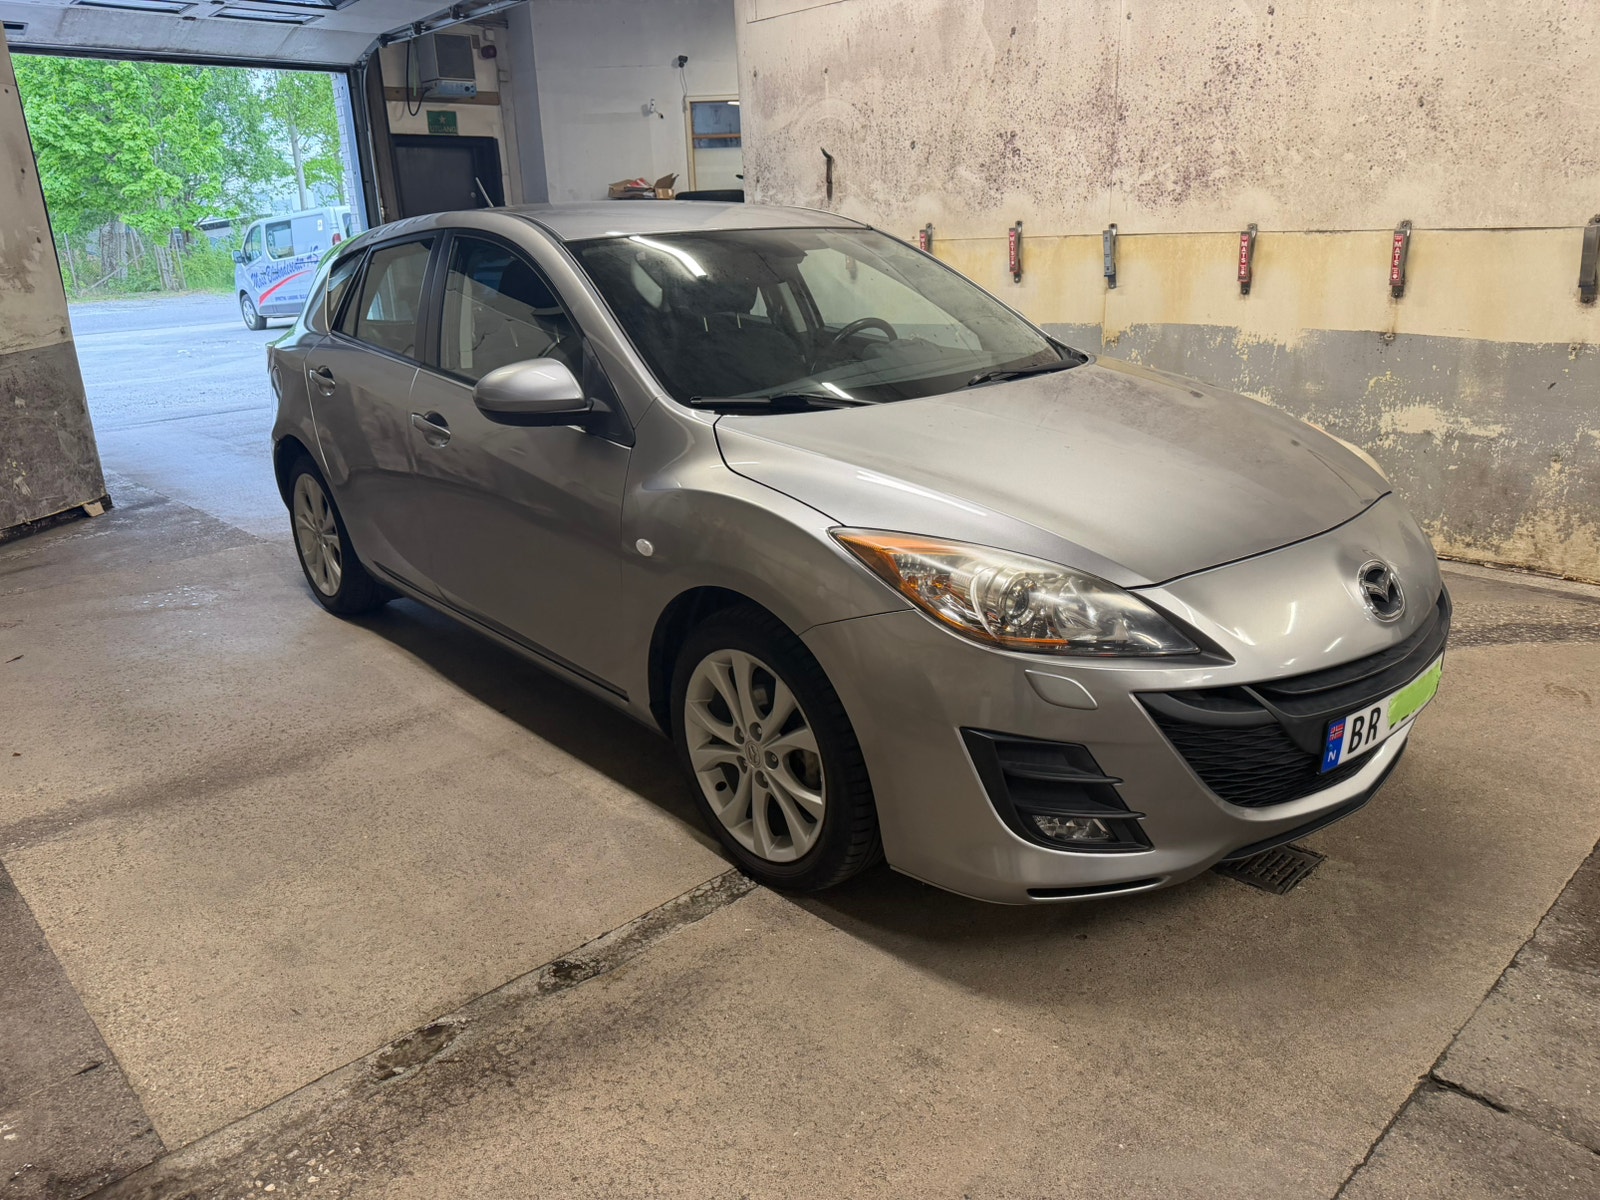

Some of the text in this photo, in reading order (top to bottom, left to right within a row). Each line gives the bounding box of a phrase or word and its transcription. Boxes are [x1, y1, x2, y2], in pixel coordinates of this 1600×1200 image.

[1394, 241, 1402, 265] MATS
[1347, 707, 1382, 754] BR
[1327, 749, 1337, 763] N
